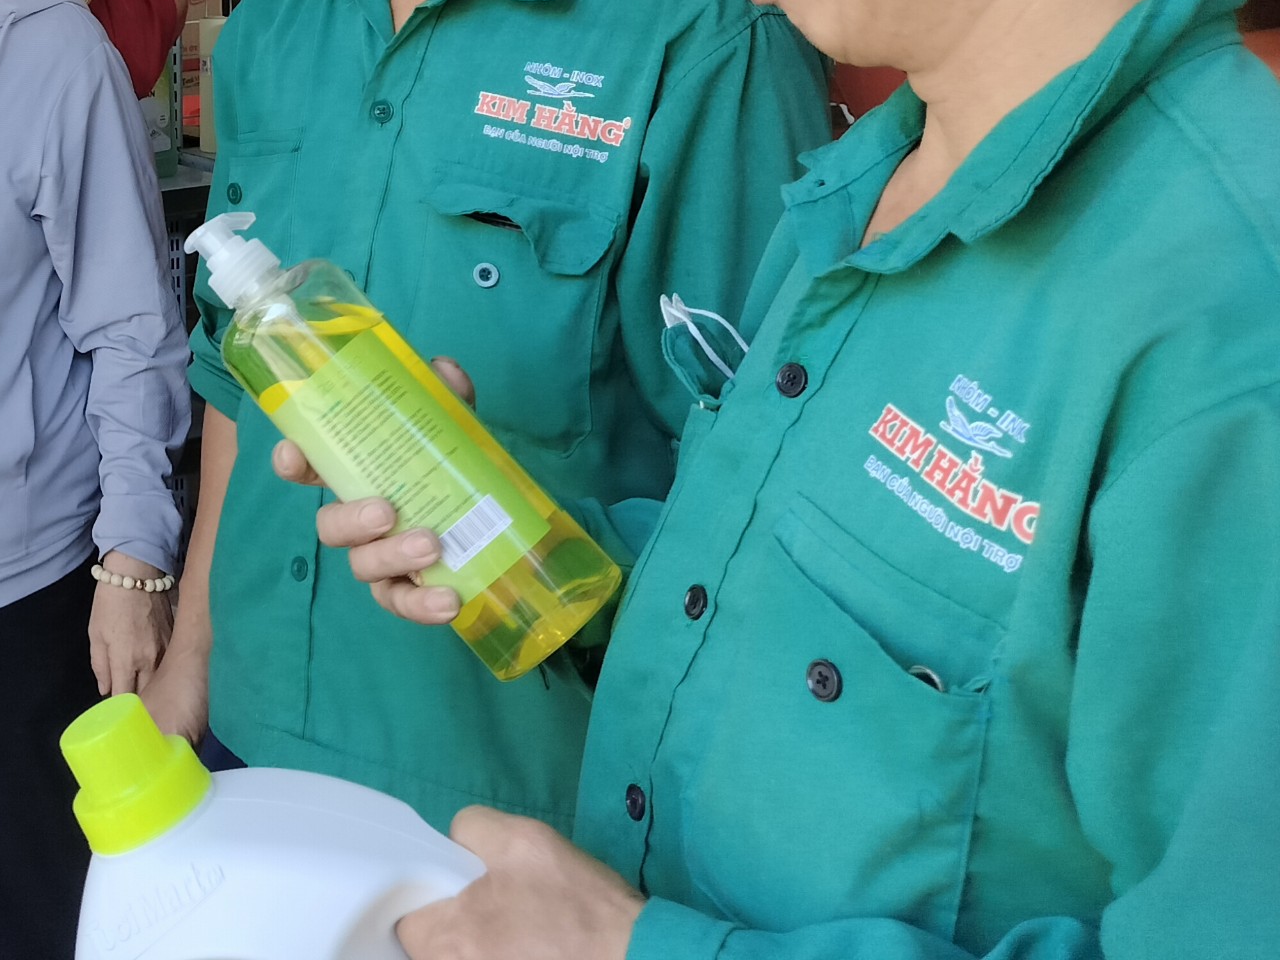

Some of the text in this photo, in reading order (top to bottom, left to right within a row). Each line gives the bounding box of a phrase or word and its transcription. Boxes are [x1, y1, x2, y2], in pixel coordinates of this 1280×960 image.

[523, 61, 563, 79] NHÔM
[570, 70, 605, 88] INOX
[474, 90, 625, 147] KIM HẰNG
[868, 402, 937, 472] KIM
